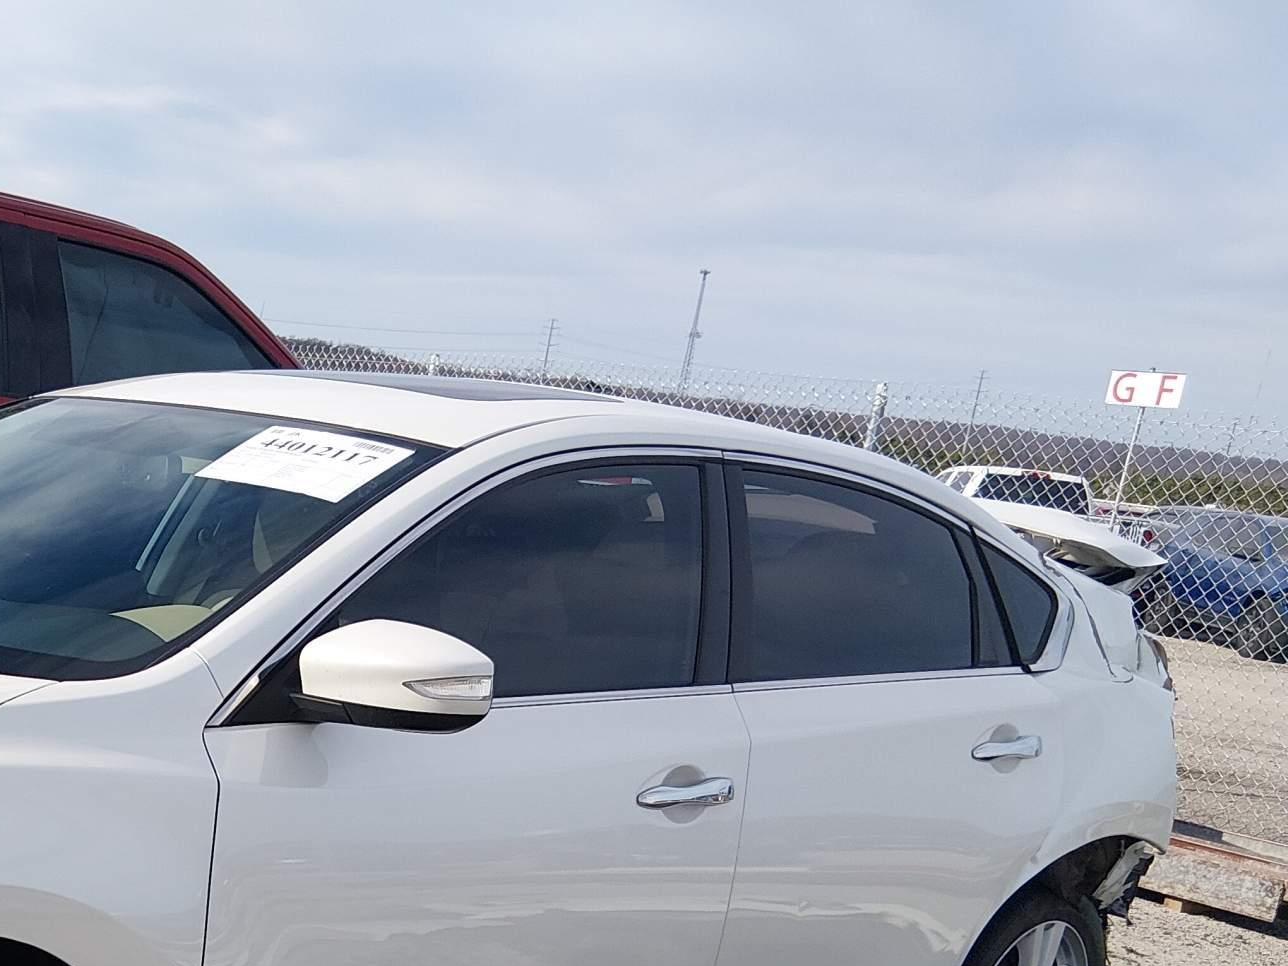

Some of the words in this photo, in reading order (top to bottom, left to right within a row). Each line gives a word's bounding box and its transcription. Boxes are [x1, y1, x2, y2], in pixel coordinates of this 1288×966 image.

[1113, 373, 1137, 402] G
[1155, 375, 1178, 406] F
[260, 438, 377, 465] 44012117
